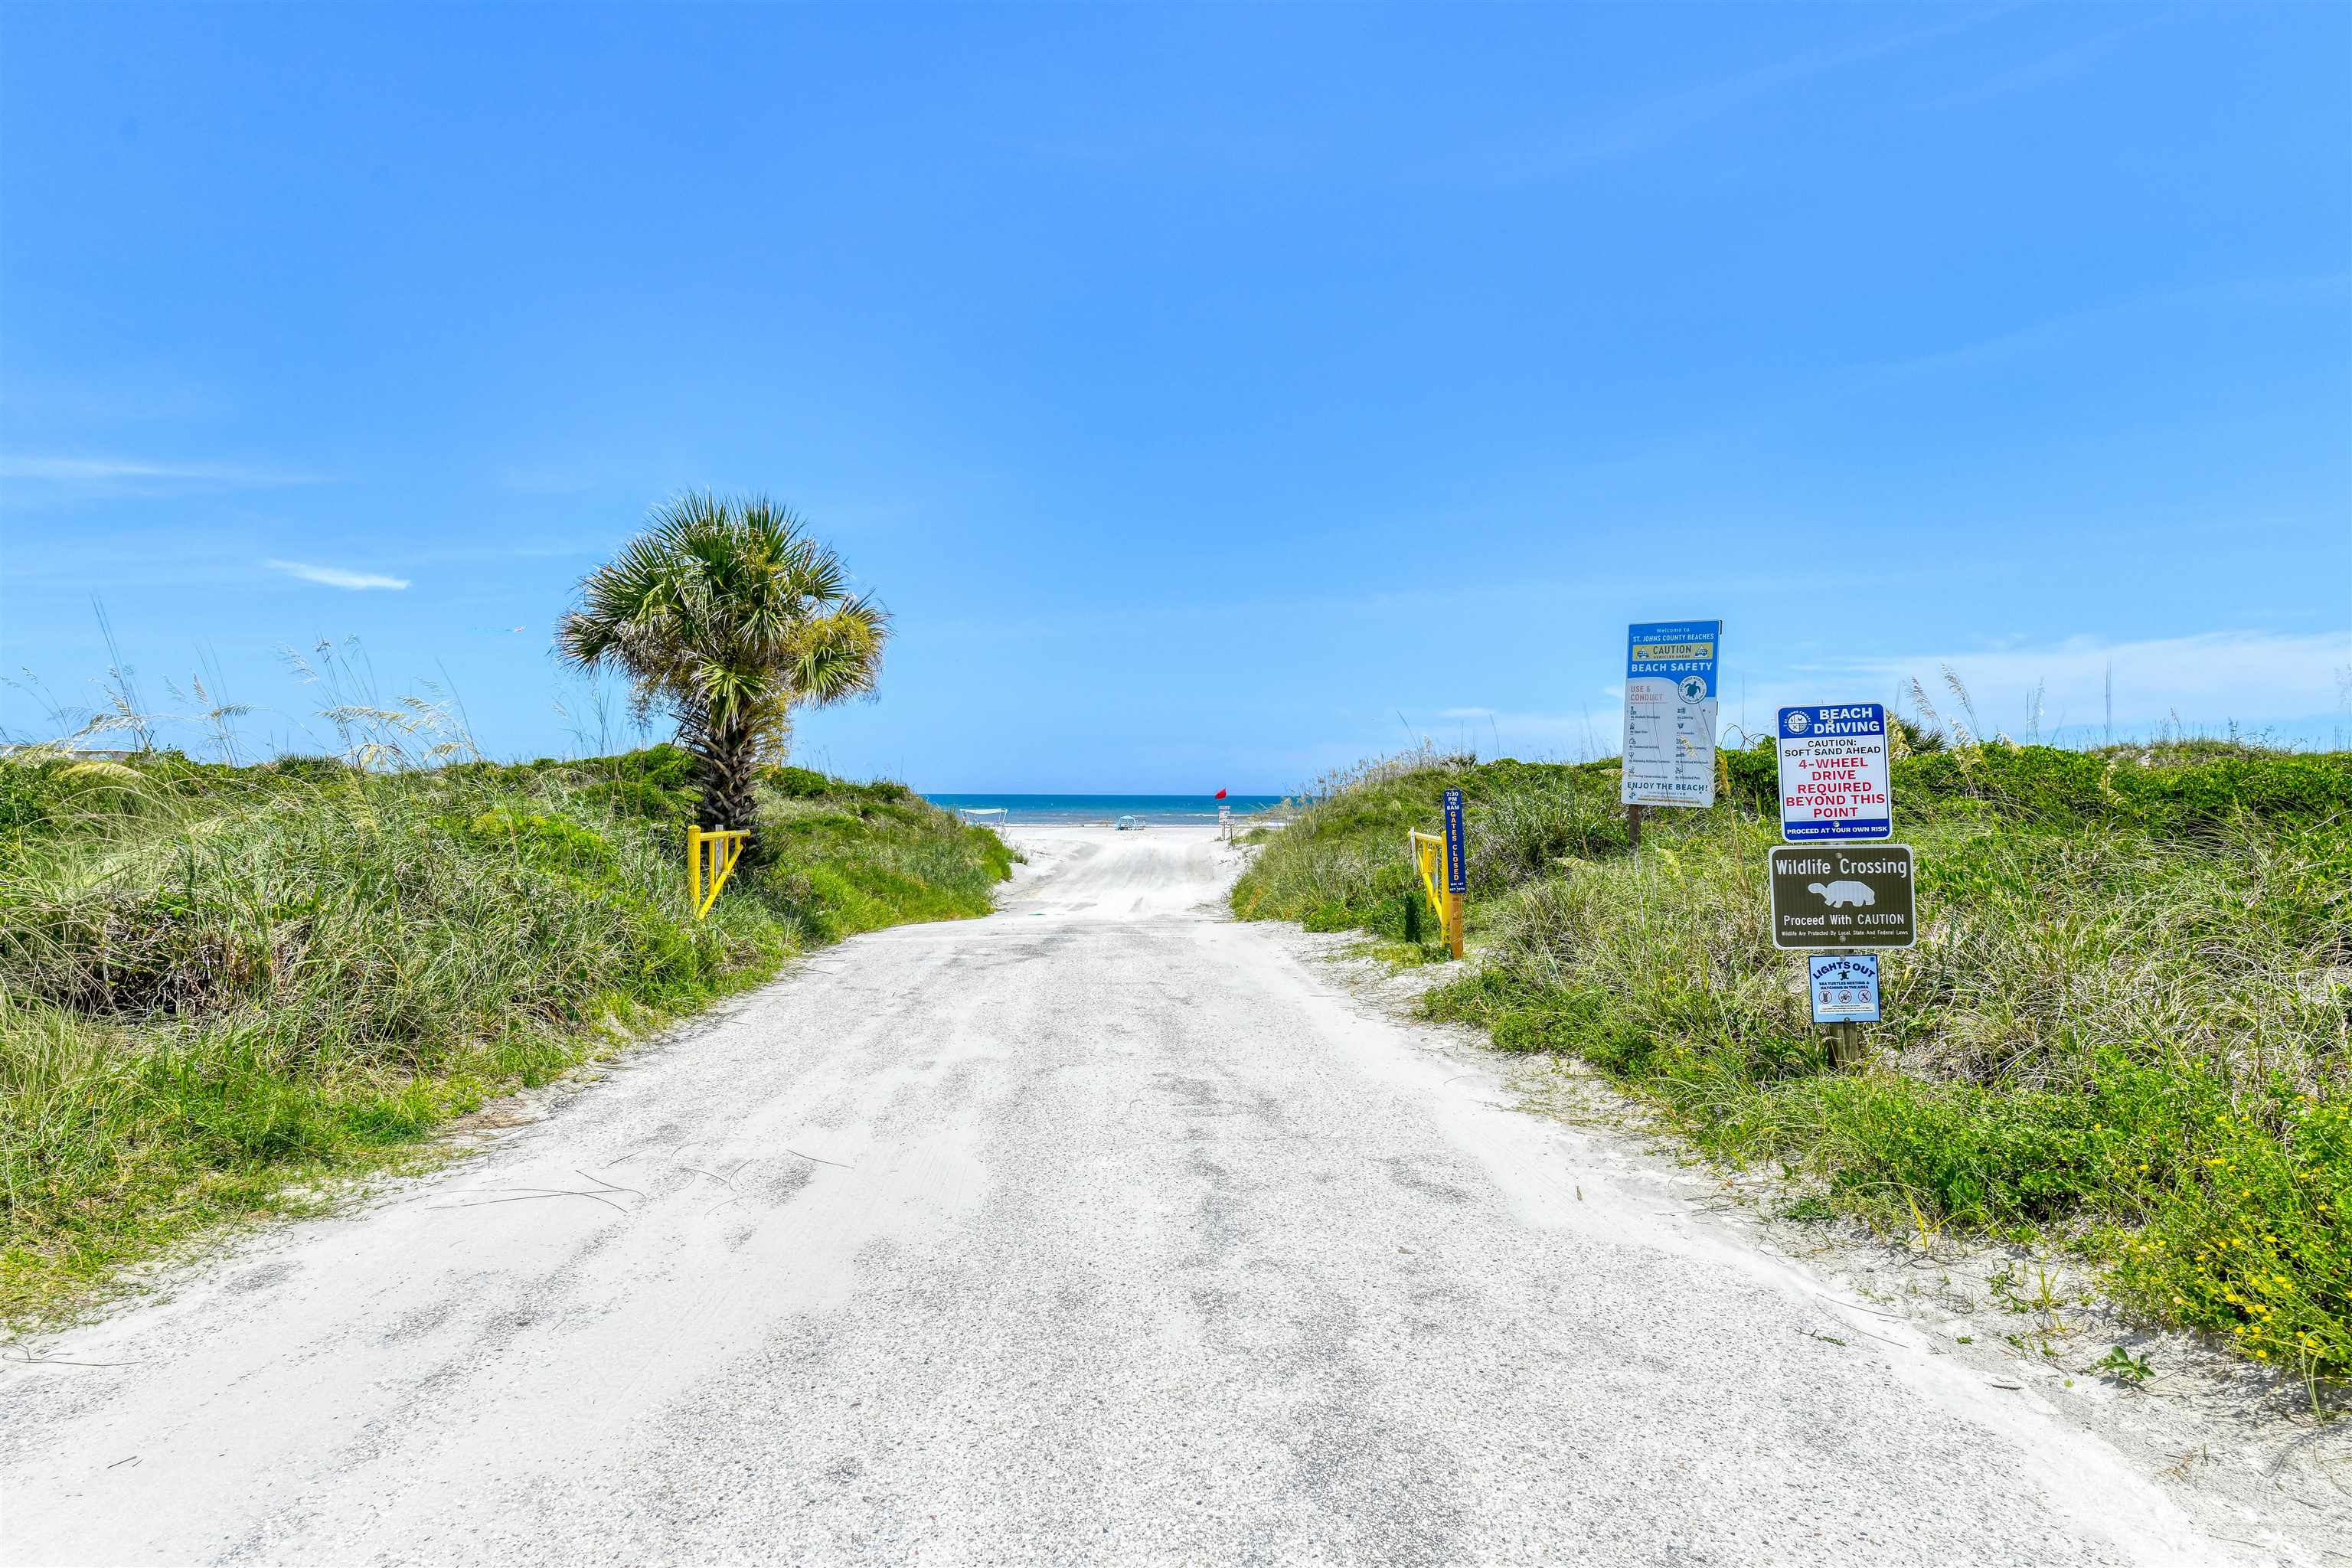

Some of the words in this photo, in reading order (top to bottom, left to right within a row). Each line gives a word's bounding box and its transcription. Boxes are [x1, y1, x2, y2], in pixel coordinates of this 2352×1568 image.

[1653, 645, 1691, 655] CAUTION
[1632, 663, 1666, 672] BEACH
[1670, 662, 1712, 671] SAFETY
[1819, 707, 1872, 720] BEACH
[1814, 721, 1880, 734] DRIVING
[1808, 739, 1856, 747] CAUTION:
[1799, 758, 1868, 769] 4-WHEEL
[1812, 770, 1856, 781] DRIVE
[1797, 782, 1872, 795] REQUIRED
[1786, 795, 1846, 806] BEYOND
[1851, 794, 1885, 804] THIS
[1814, 807, 1858, 818] POINT
[1776, 859, 1831, 875] Wildlife
[1840, 858, 1907, 878] Crossing
[1784, 915, 1824, 925] Proceed
[1830, 914, 1852, 925] With
[1858, 914, 1905, 925] CAUTION
[1813, 961, 1851, 980] LIGHTS
[1853, 963, 1875, 977] OUT
